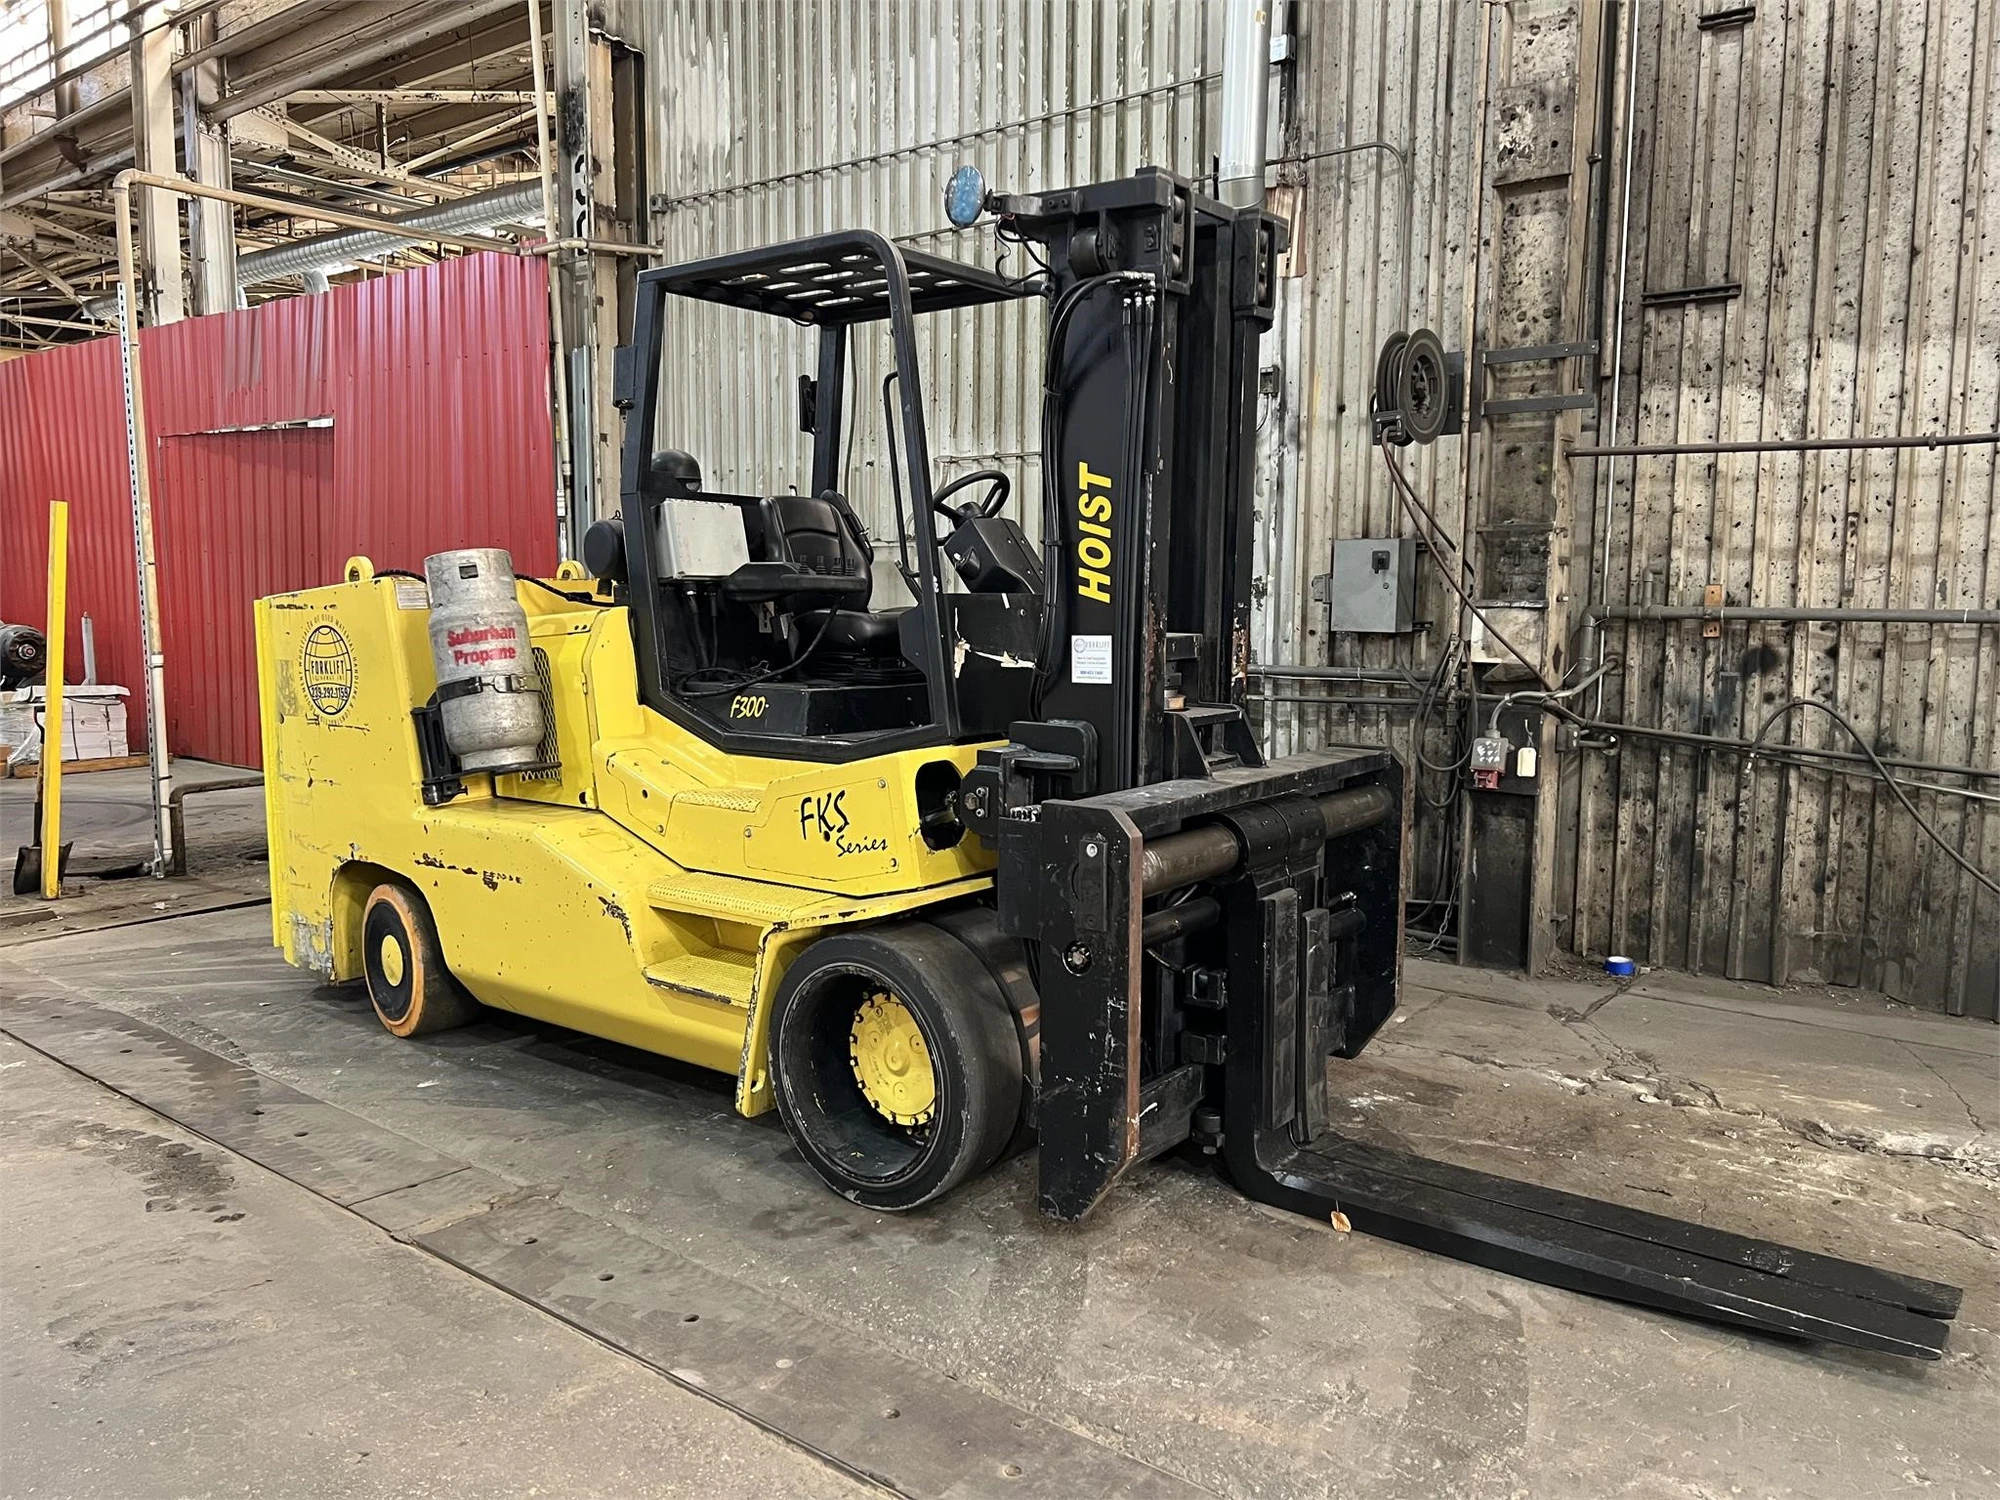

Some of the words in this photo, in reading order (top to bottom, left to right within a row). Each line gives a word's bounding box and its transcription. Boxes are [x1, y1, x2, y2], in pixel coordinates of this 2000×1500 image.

[1078, 461, 1112, 604] HOIST
[447, 625, 516, 647] Suburban
[311, 660, 344, 674] FORKLIFT
[453, 647, 516, 666] Propane
[730, 695, 766, 718] F300
[800, 790, 850, 840] FKS
[836, 834, 888, 857] Series
